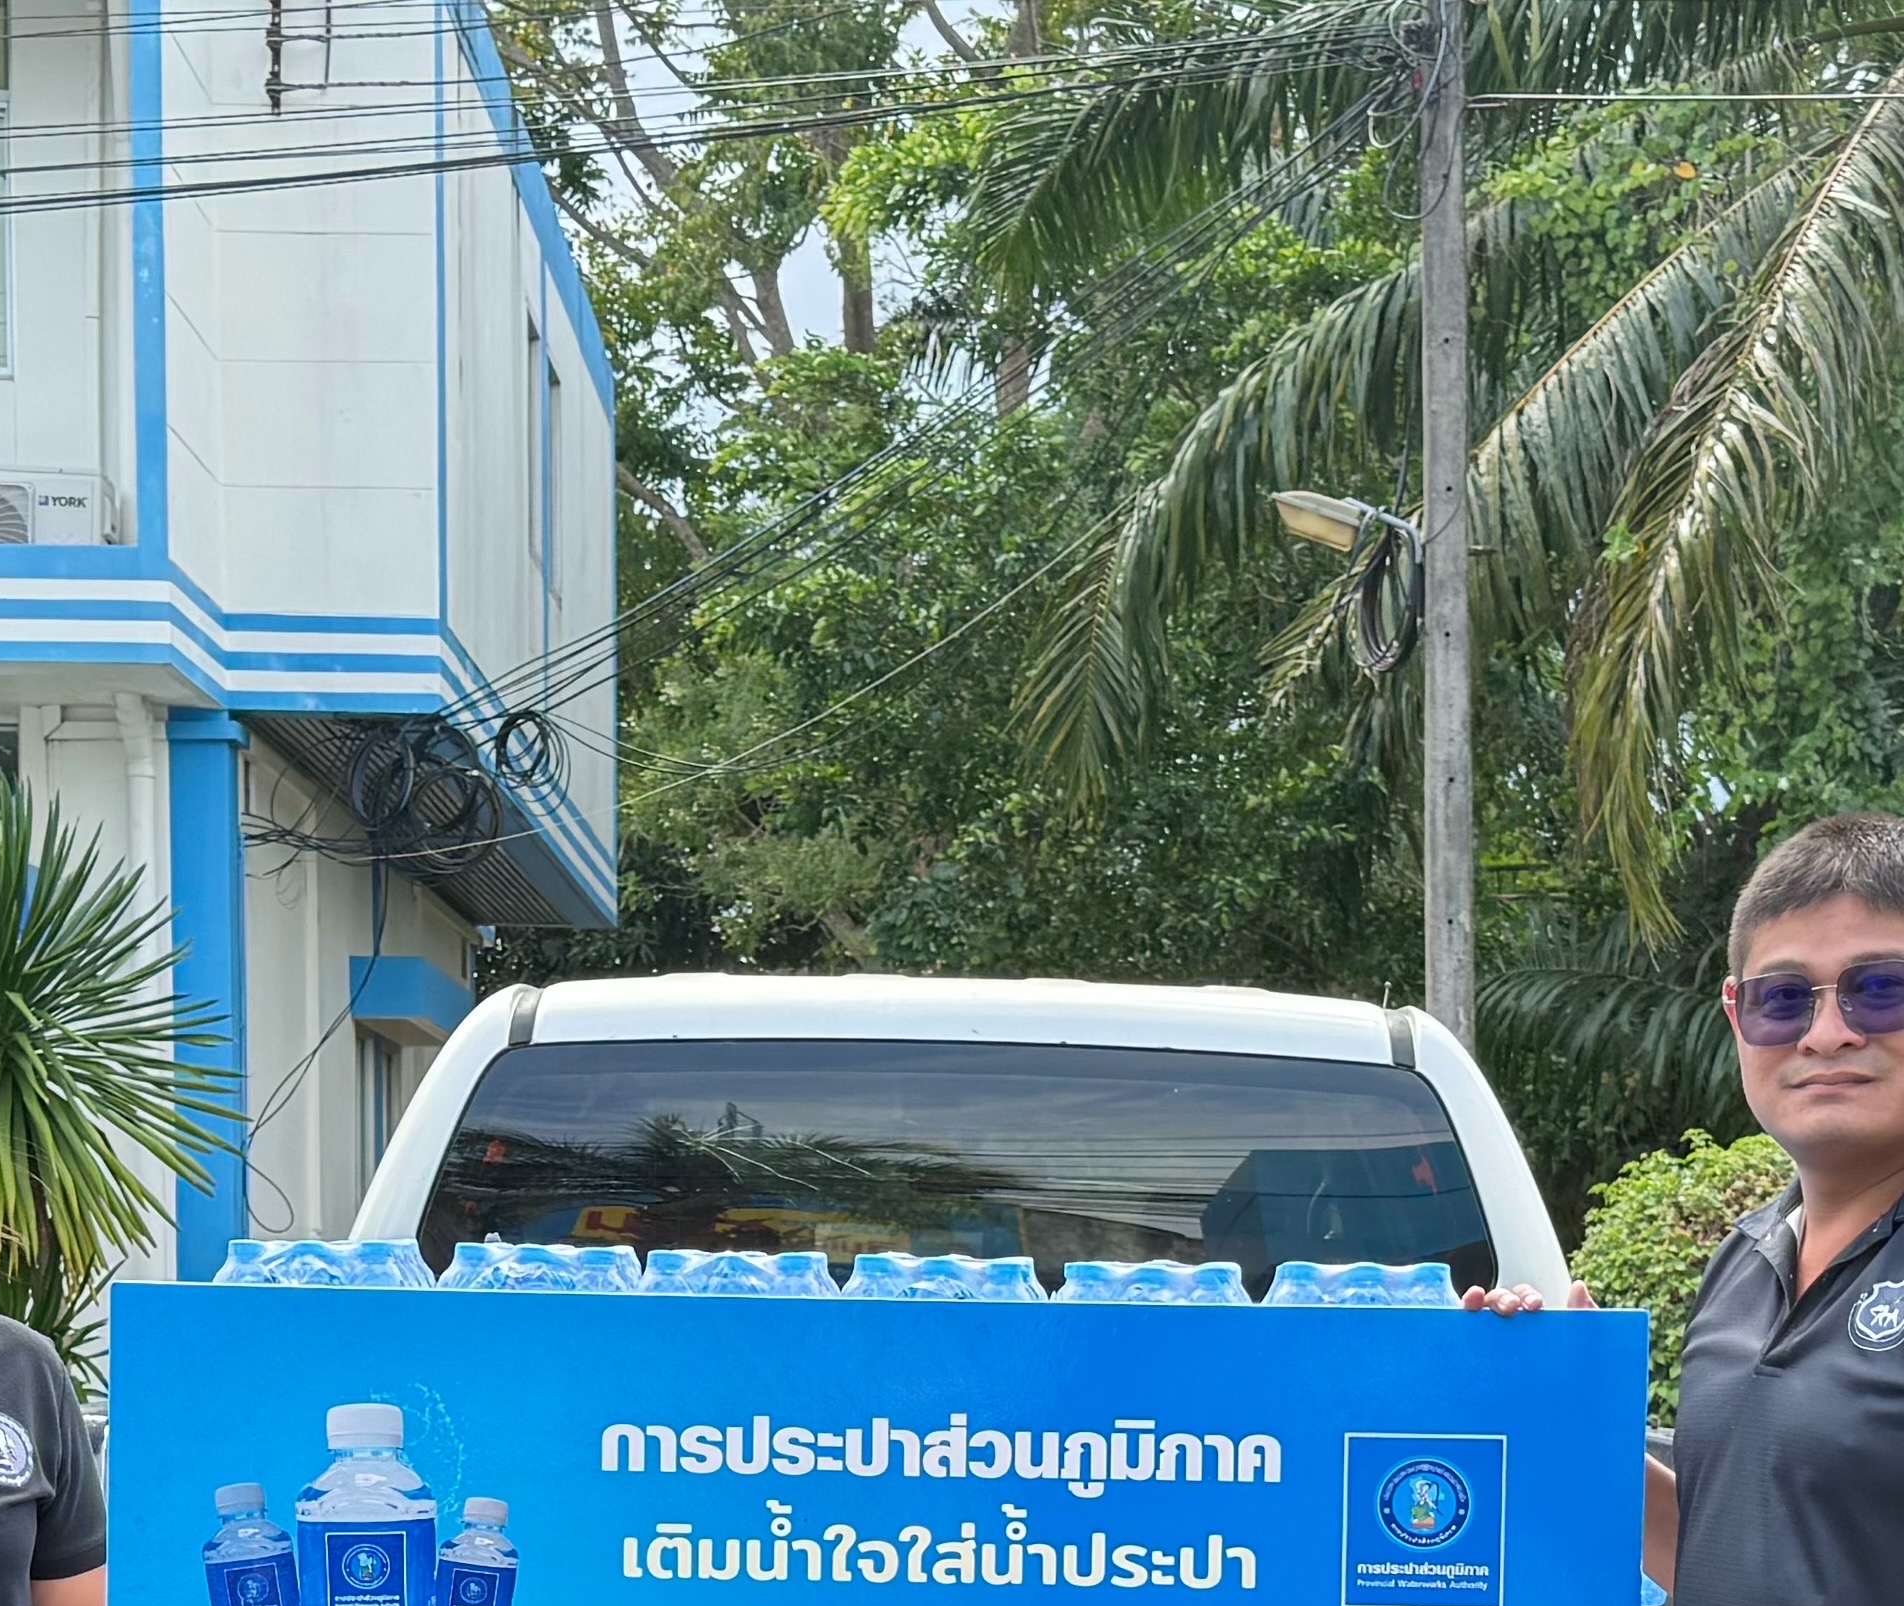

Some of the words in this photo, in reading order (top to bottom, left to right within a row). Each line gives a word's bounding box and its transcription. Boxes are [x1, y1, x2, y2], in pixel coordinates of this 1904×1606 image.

[51, 496, 88, 508] YORK
[600, 1412, 1282, 1498] การประปาส่วนภูมิภาค
[622, 1498, 1257, 1591] เติมน้ำใจใส่น้ำประปา
[1357, 1561, 1489, 1580] การประปาส่วนภูมิภาค
